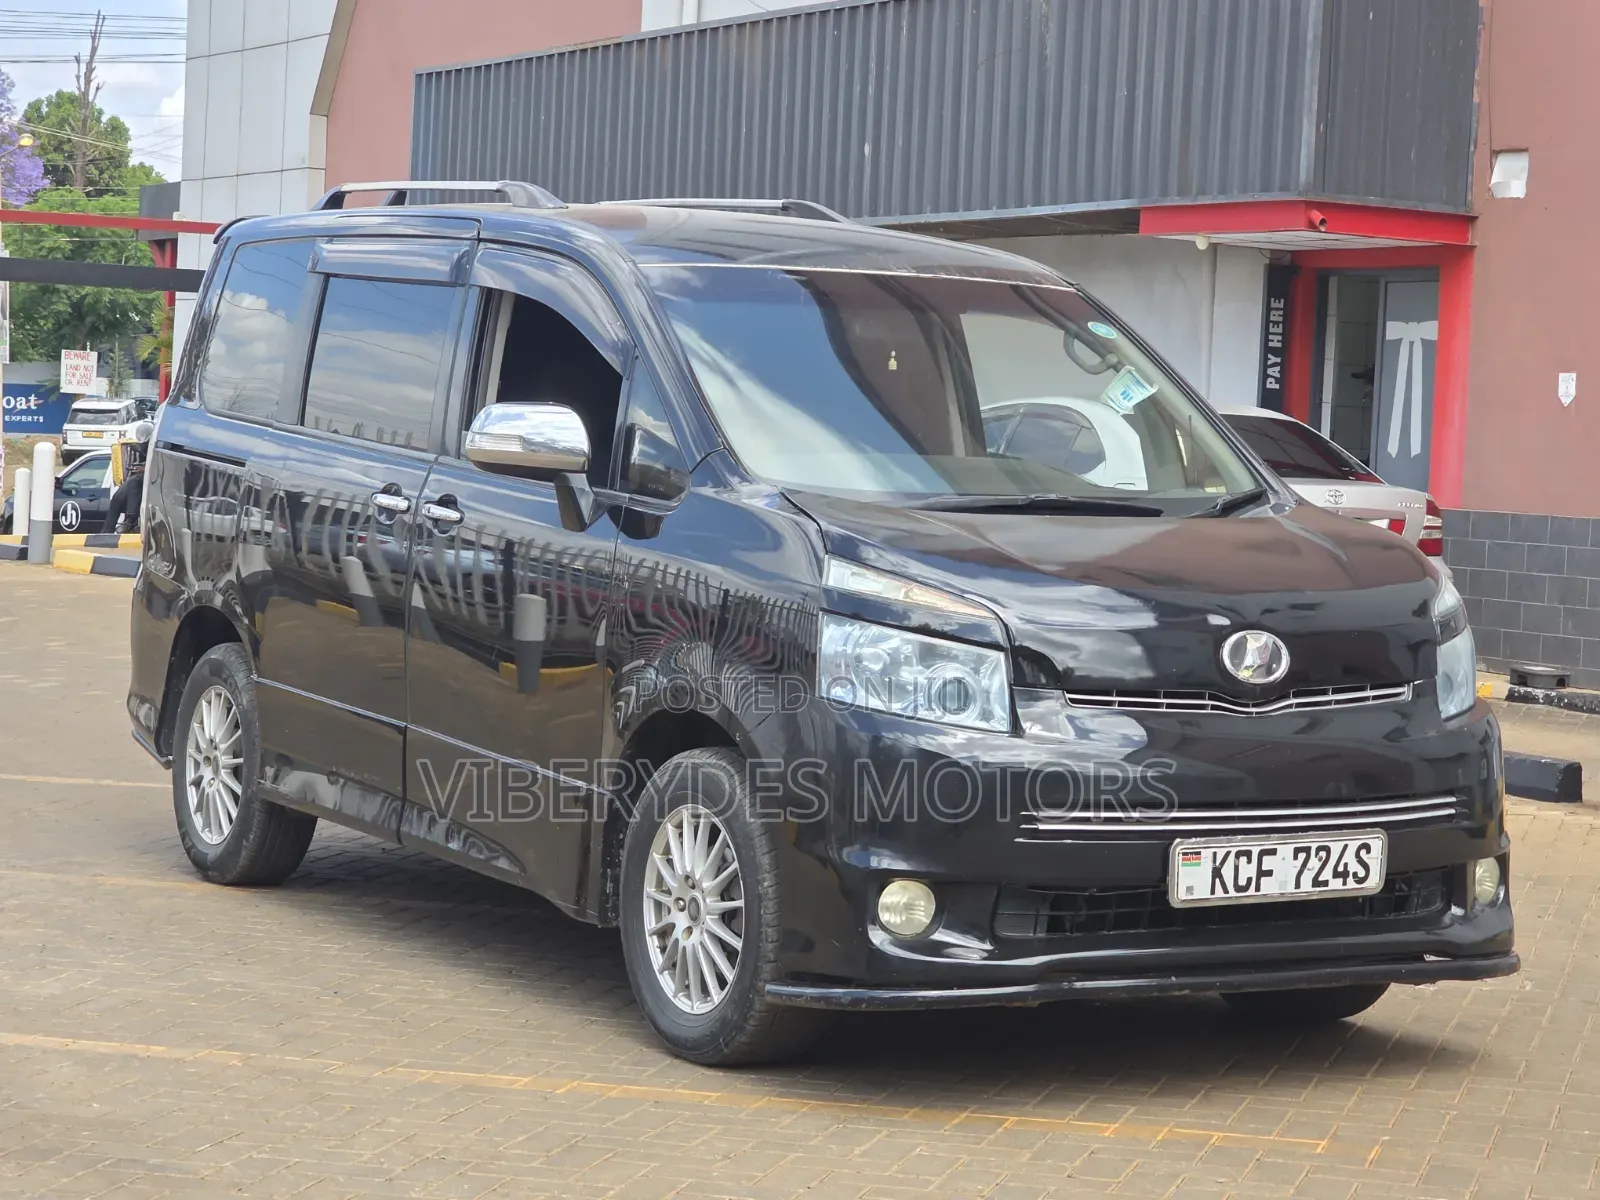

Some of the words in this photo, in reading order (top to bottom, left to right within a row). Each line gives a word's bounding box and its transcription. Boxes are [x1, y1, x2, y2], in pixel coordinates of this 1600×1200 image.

[1268, 297, 1285, 347] HERE
[64, 350, 92, 361] BEWARE
[65, 364, 81, 372] LAND
[83, 364, 94, 372] NOT
[1266, 353, 1281, 389] PAY
[65, 371, 76, 379] FOR
[79, 372, 94, 380] SALE
[77, 379, 92, 387] RENT
[4, 415, 44, 423] EXPERTS
[1209, 847, 1278, 895] KCF
[1292, 842, 1372, 889] 724S
